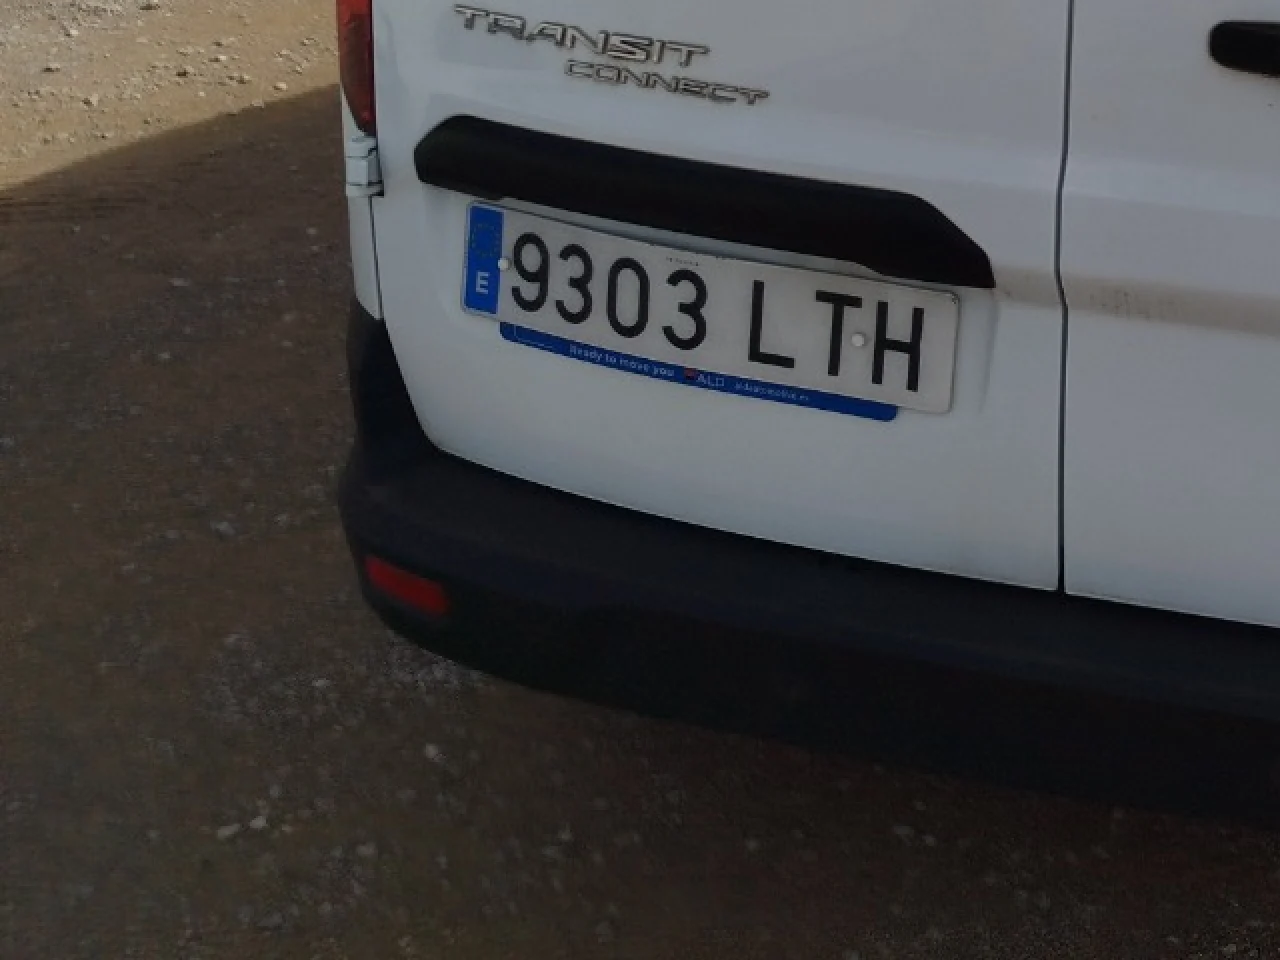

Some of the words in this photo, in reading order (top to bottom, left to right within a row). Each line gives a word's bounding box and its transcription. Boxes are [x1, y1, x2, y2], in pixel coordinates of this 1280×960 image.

[454, 4, 710, 67] TRANSIT
[564, 59, 770, 105] CONNECT
[475, 271, 490, 295] E
[511, 232, 708, 350] 9303
[748, 279, 925, 392] LTH
[569, 343, 602, 362] Ready
[605, 354, 617, 364] to
[620, 358, 650, 373] move
[653, 364, 675, 377] you
[696, 373, 725, 387] ALD
